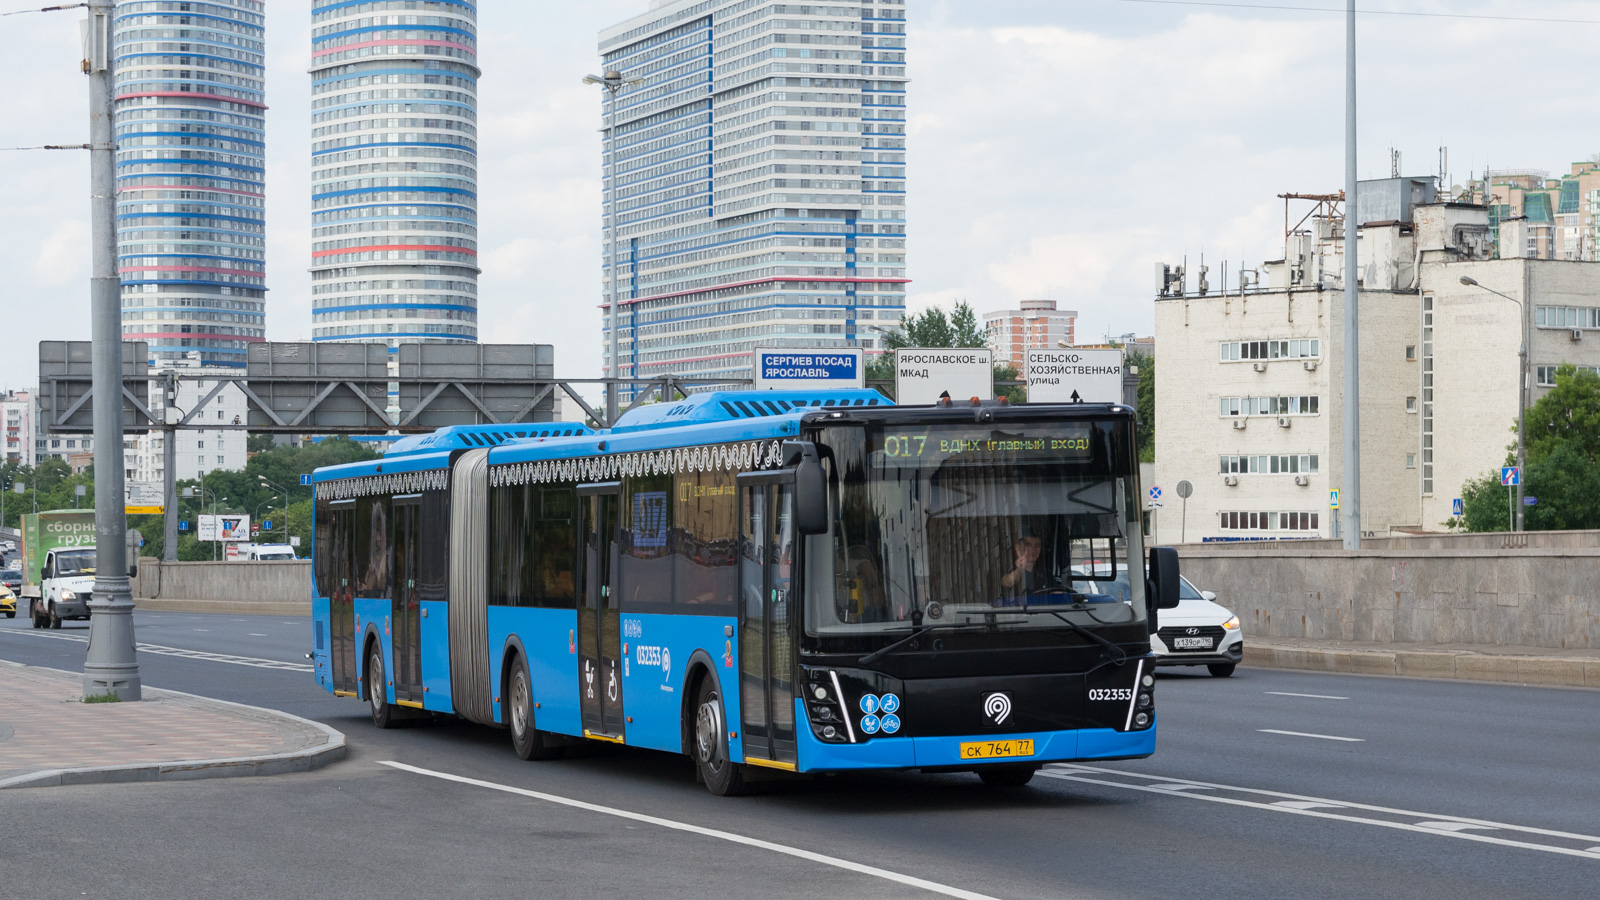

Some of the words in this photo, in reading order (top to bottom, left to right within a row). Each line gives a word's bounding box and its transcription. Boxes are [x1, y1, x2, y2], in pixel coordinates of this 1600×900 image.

[765, 356, 813, 366] СЕРГИЕВ
[815, 357, 852, 368] ПОСАД
[900, 355, 976, 364] ЯРОСЛАВСКОЕ
[1029, 354, 1083, 363] СЕЛЬСКО-
[765, 368, 830, 378] ЯРОСЛАВЛЬ
[900, 369, 929, 378] МКАД
[1029, 364, 1120, 374] ХОЗЯЙСТВЕННАЯ
[1029, 377, 1060, 386] улица
[884, 435, 927, 457] 017
[940, 439, 980, 453] ВДНХ
[987, 437, 1045, 451] (главный
[1051, 437, 1090, 450] вход)
[636, 645, 661, 666] 032353
[1088, 689, 1132, 701] 032353
[987, 742, 1011, 756] 764
[1017, 740, 1030, 750] 77
